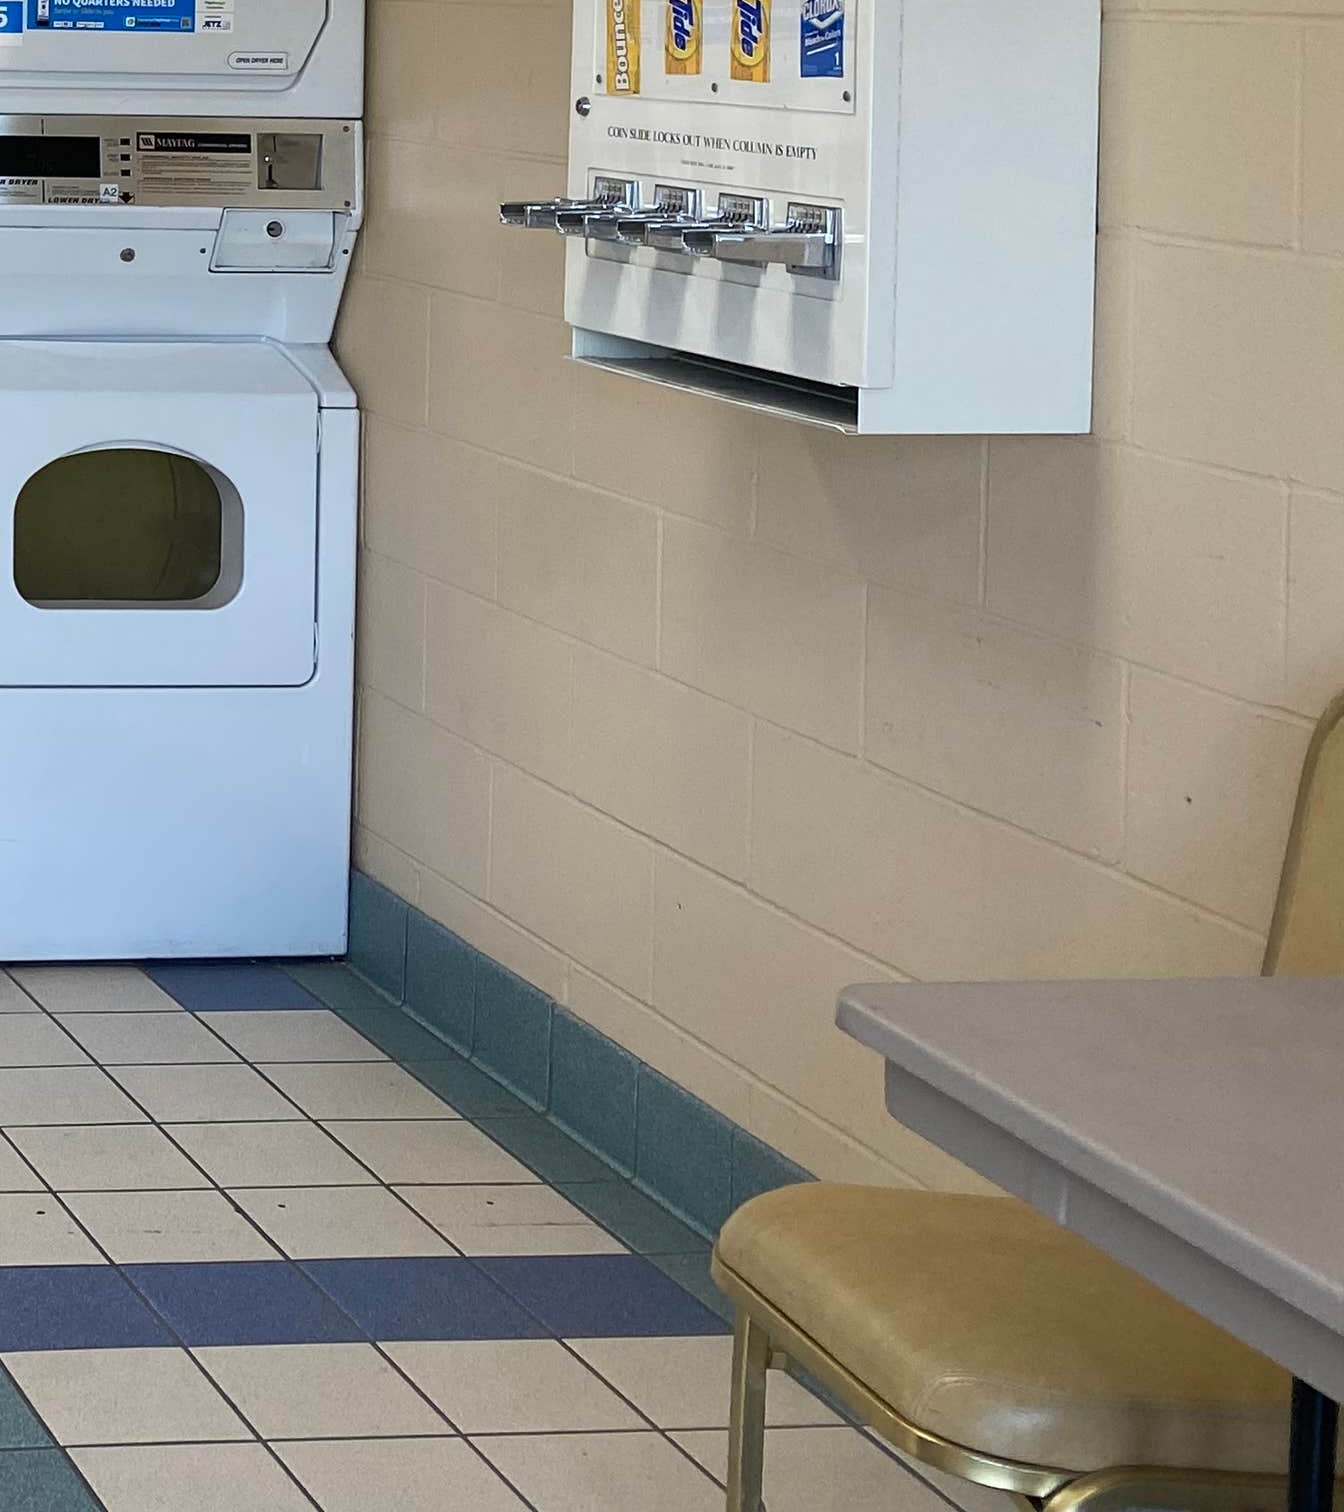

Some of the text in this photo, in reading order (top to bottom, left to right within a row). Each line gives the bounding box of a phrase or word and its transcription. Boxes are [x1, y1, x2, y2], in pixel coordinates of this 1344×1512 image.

[834, 51, 840, 66] 1
[156, 138, 195, 147] MAYTAG
[608, 126, 818, 160] COIN SLIDE LOCKS OUT WHEN COLUMN IS EMPTY
[102, 188, 117, 197] A2
